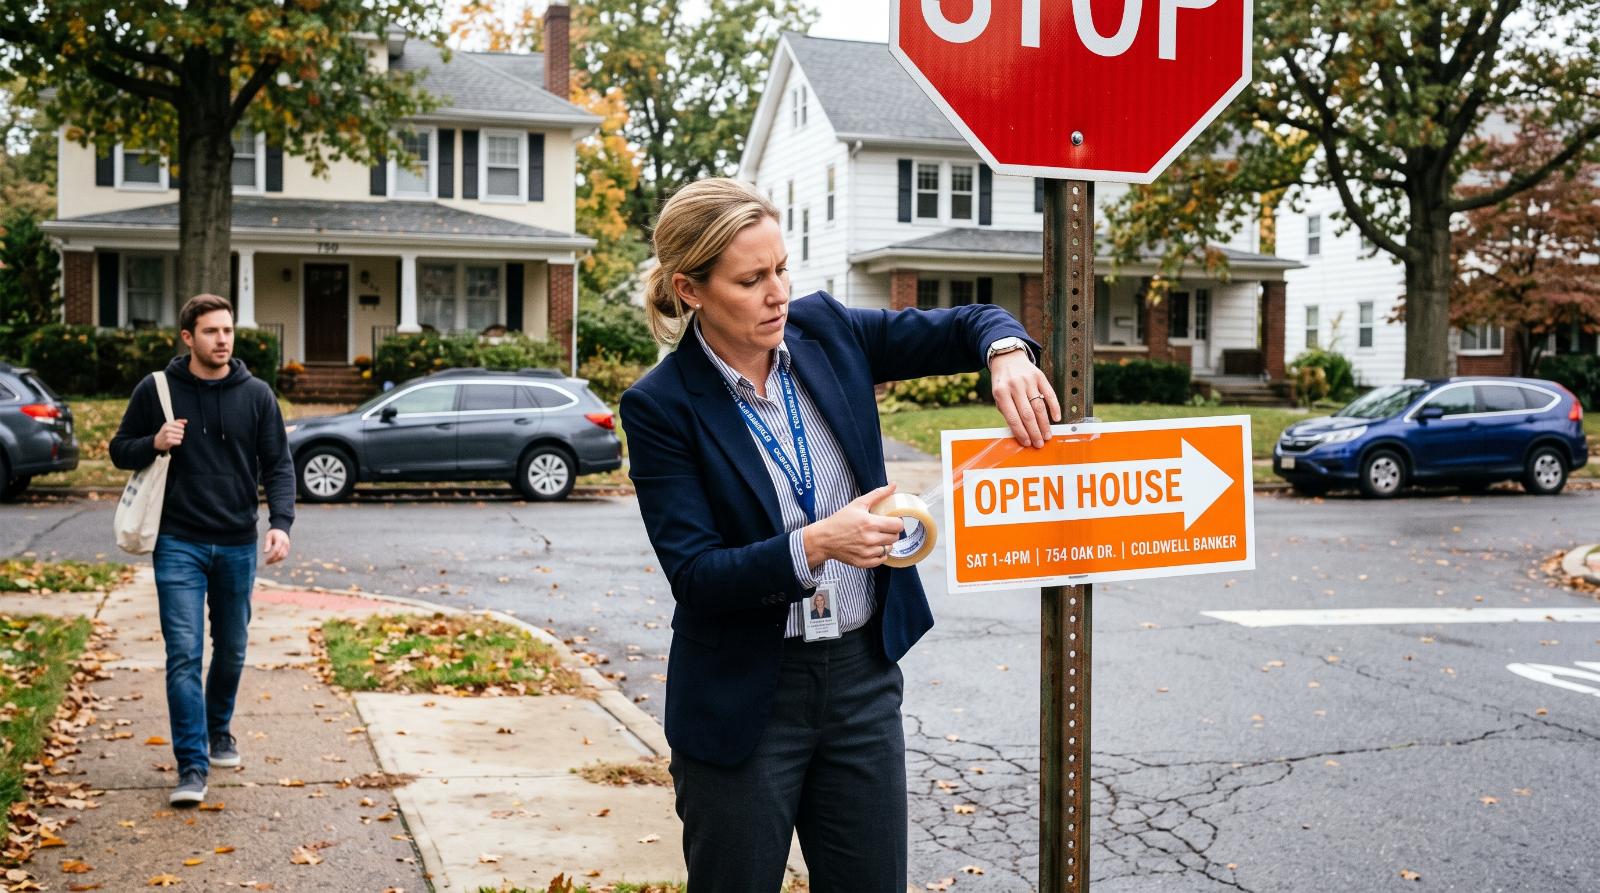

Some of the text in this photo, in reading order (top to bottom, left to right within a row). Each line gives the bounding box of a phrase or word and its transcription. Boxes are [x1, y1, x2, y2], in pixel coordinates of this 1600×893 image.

[974, 468, 1184, 515] OPEN HOUSE
[966, 553, 988, 569] SAT
[991, 550, 1031, 567] 1-4PM
[1046, 547, 1068, 562] 754
[1070, 545, 1094, 561] OAK
[1097, 543, 1117, 559] DR.
[1130, 538, 1191, 556] COLDWELL
[1193, 534, 1237, 551] BANKER
